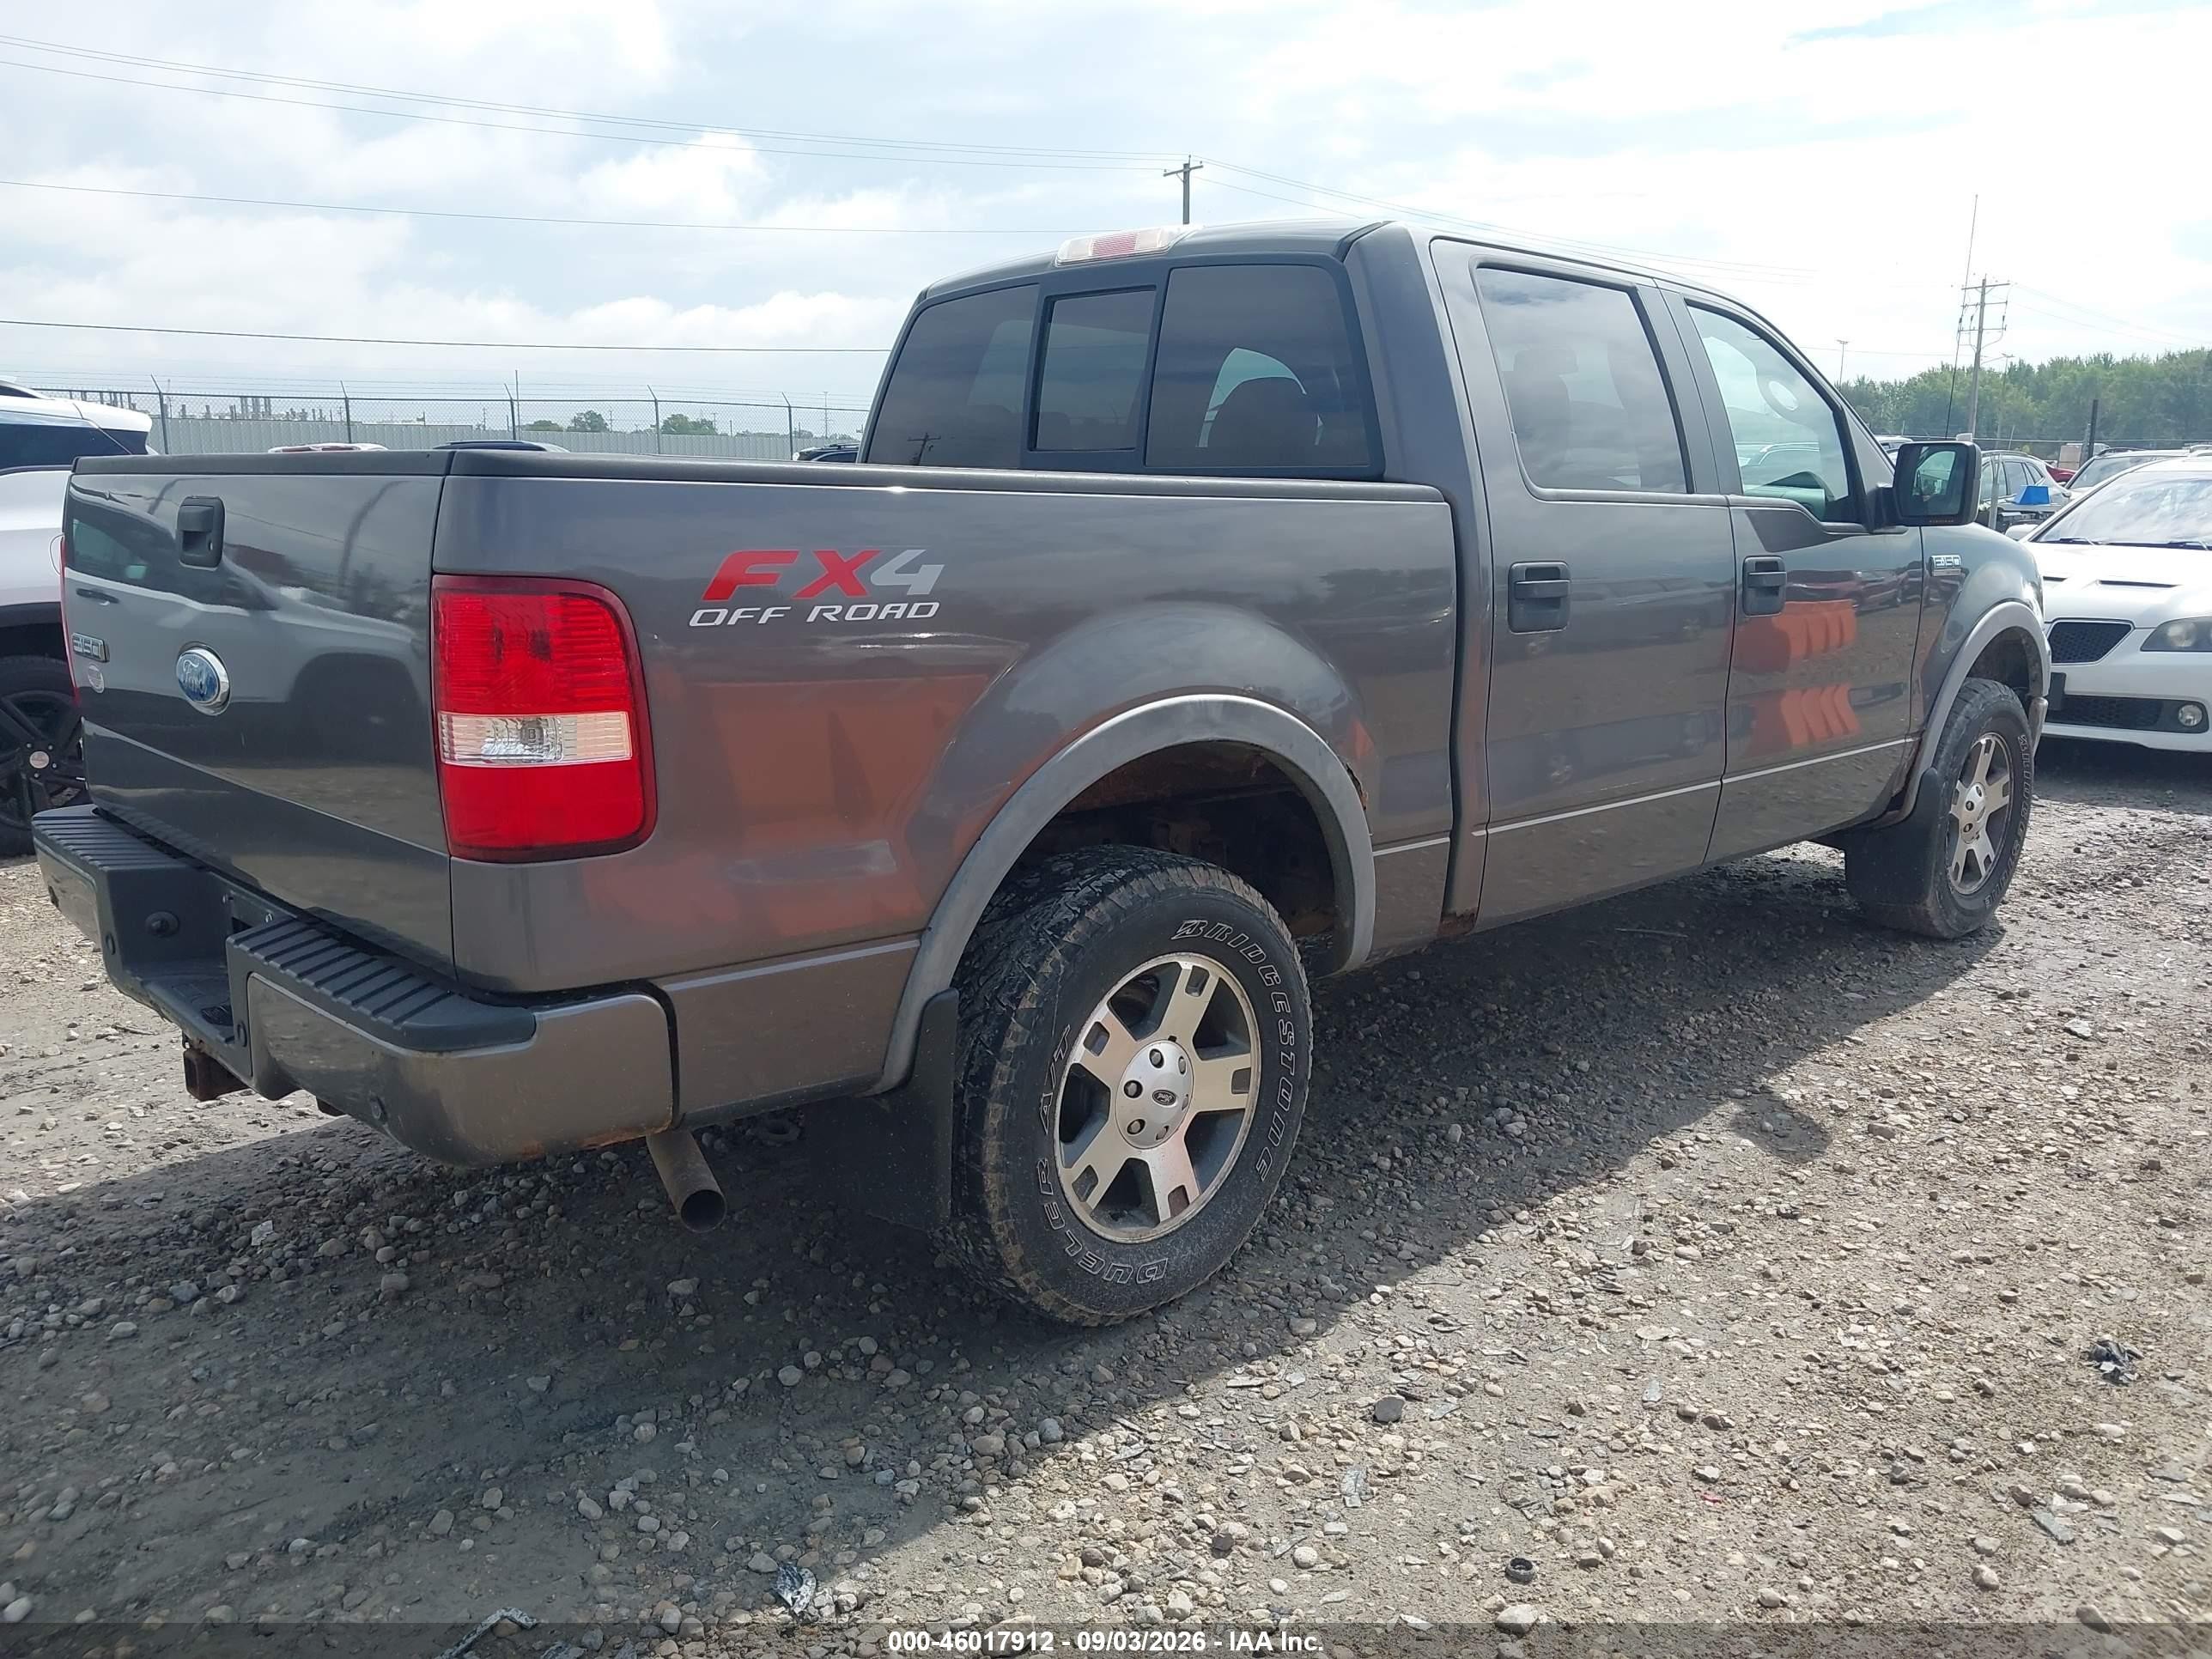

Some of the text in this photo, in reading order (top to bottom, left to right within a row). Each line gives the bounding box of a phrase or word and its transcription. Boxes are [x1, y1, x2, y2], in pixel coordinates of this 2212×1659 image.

[689, 601, 940, 627] OFF ROAD
[702, 549, 945, 601] FX4
[1171, 920, 1296, 1182] BRIDGESTONE
[1036, 1158, 1169, 1284] DUELER
